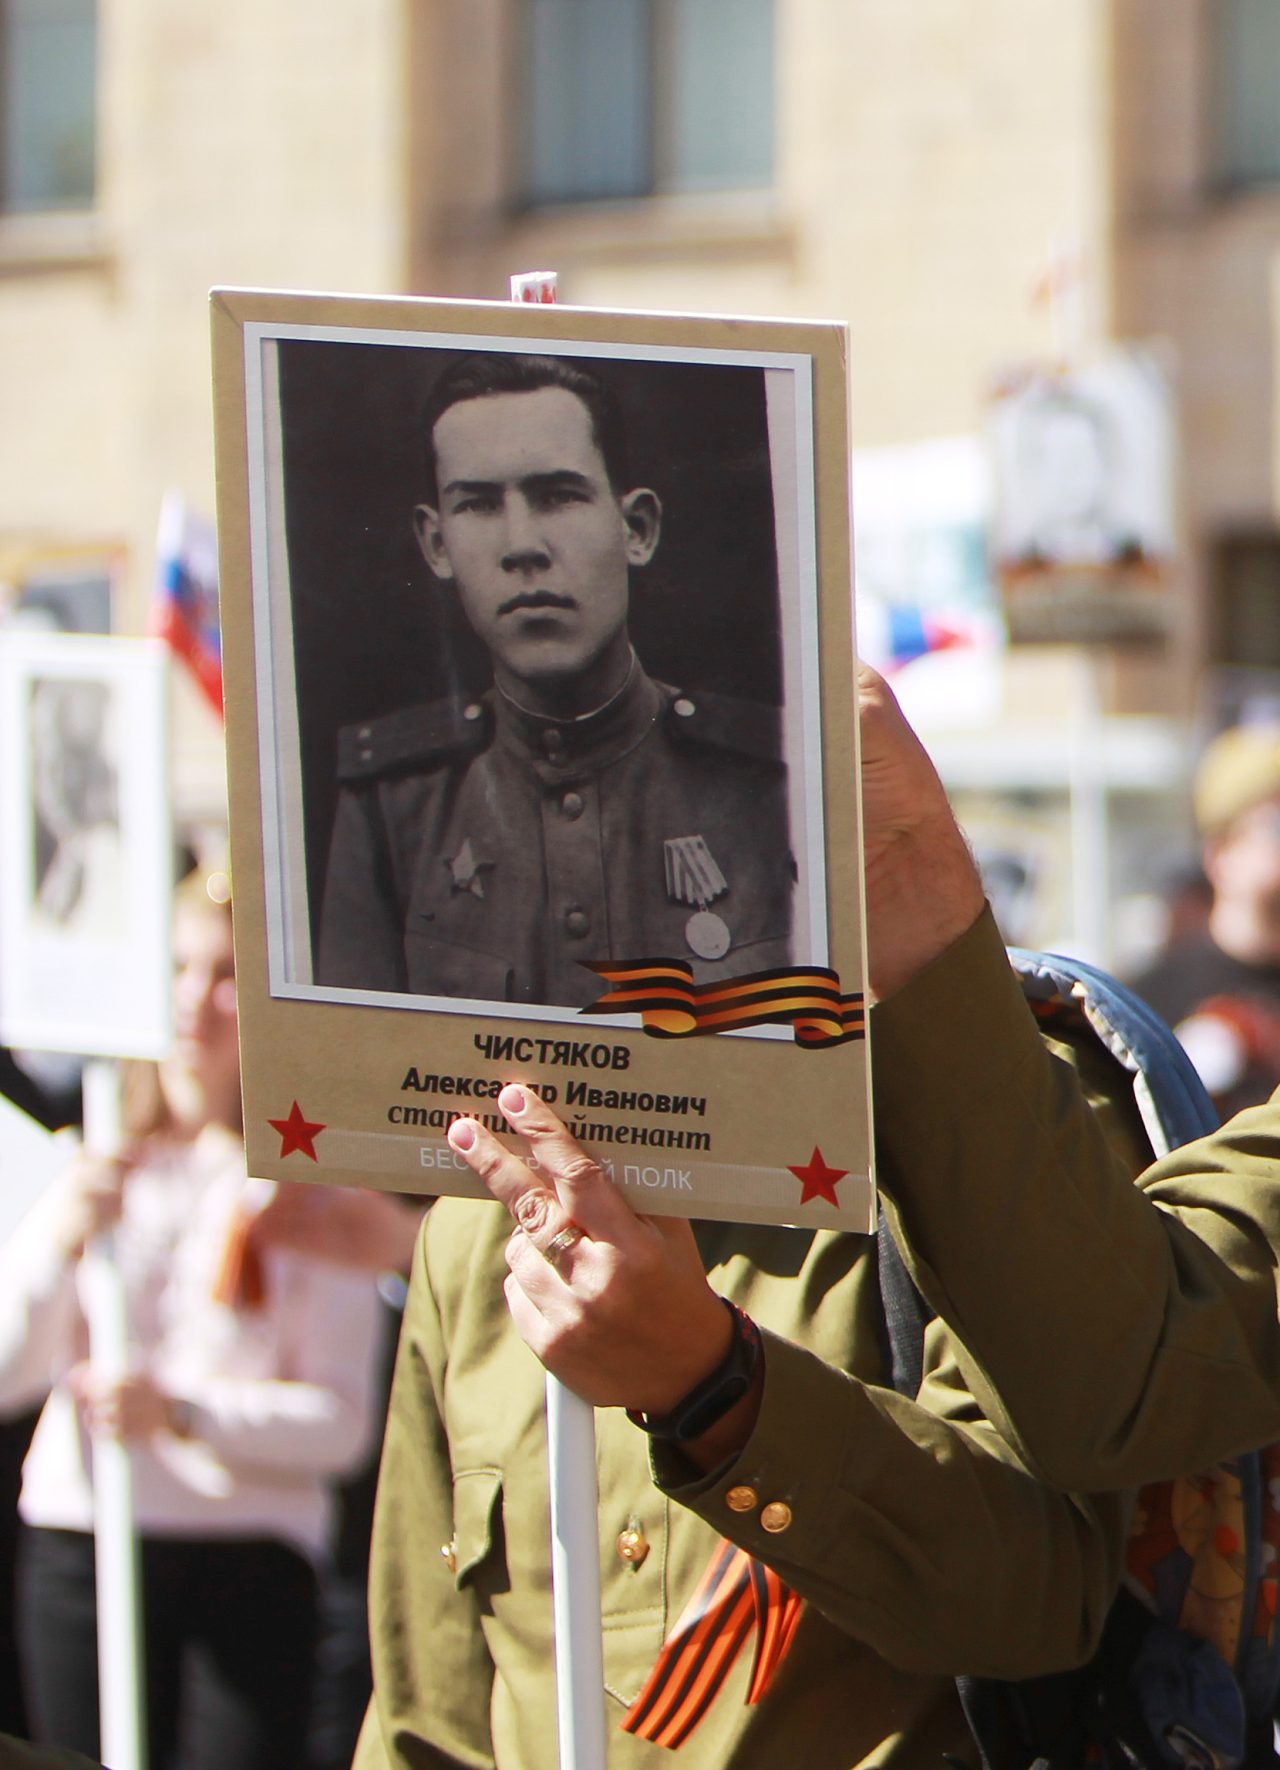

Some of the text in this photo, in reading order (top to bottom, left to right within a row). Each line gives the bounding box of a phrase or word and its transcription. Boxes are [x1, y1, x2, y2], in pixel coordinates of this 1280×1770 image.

[474, 1034, 631, 1070] ЧИСТЯКОВ
[565, 1081, 706, 1117] Иванович
[624, 1165, 692, 1190] ПОЛК
